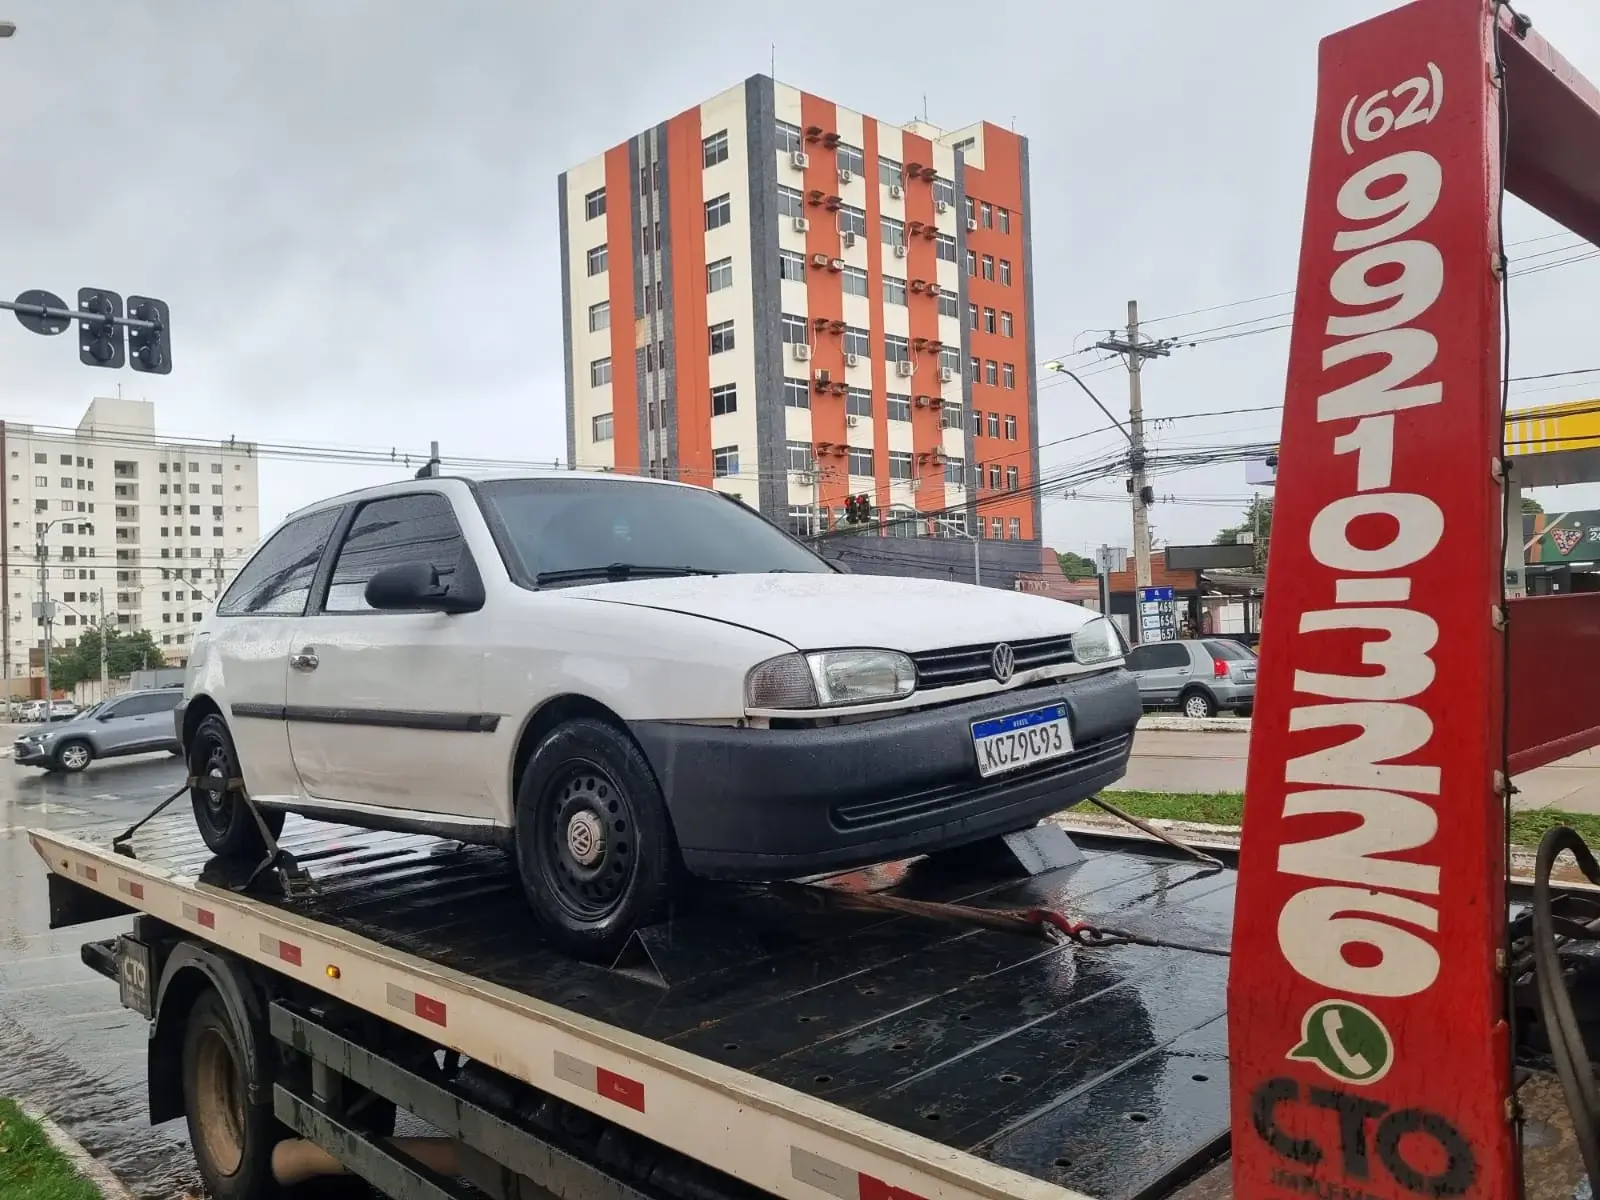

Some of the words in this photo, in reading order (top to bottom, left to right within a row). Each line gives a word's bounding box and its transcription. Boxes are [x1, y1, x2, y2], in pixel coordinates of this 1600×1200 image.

[1341, 62, 1443, 154] (62)
[1277, 151, 1444, 996] 99210-3226
[984, 723, 1062, 768] KCZ9C93
[124, 955, 146, 990] CTO
[1252, 1077, 1477, 1198] CTO
